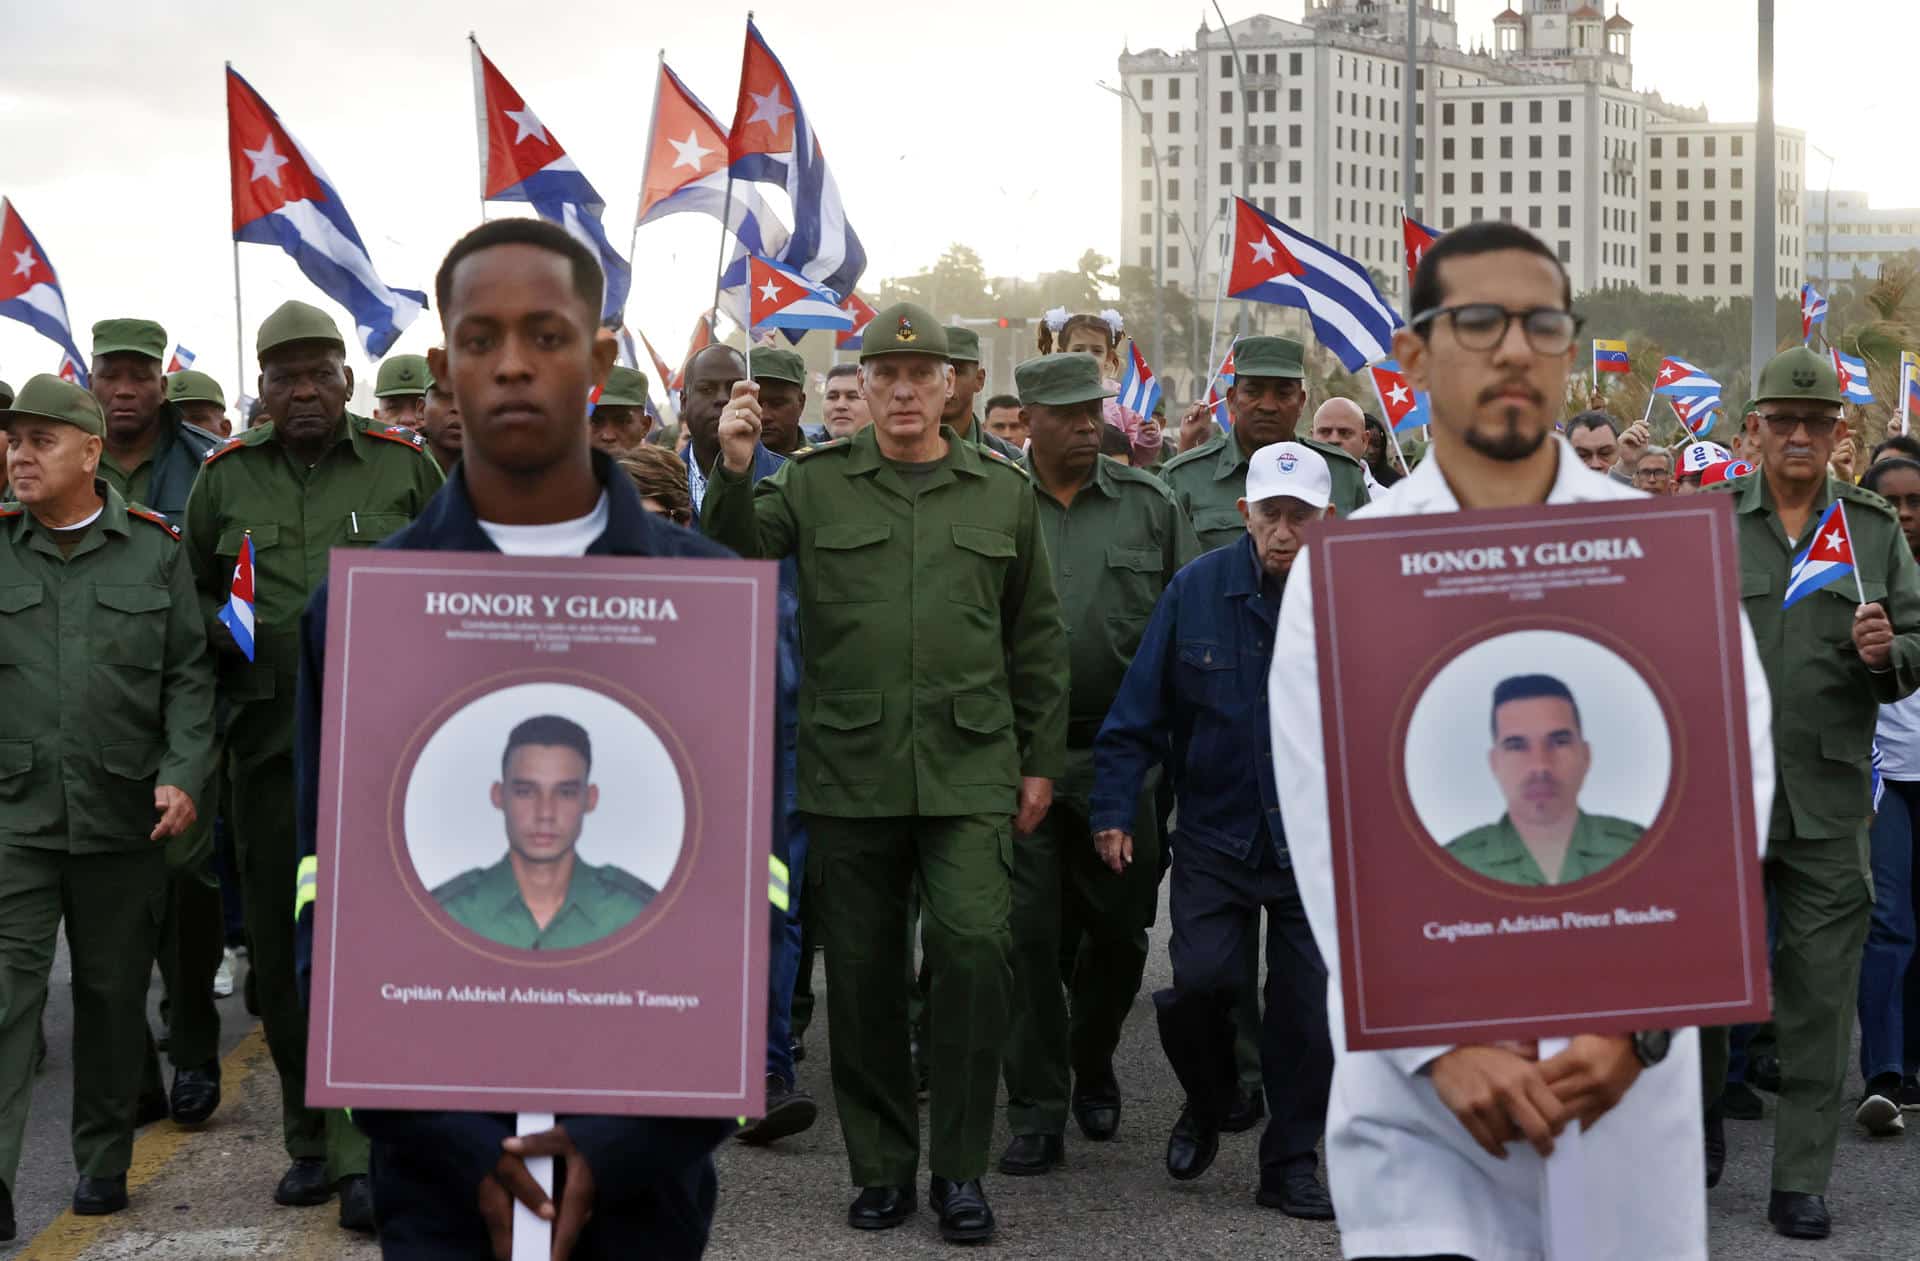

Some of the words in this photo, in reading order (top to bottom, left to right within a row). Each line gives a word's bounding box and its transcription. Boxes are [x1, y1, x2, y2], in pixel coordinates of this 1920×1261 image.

[1401, 547, 1506, 576] HONOR
[1510, 546, 1530, 567] Y
[1534, 537, 1644, 566] GLORIA
[425, 592, 534, 617] HONOR
[541, 596, 560, 617] Y
[566, 596, 678, 621] GLORIA
[381, 983, 442, 1004] Capitán
[510, 987, 565, 1004] Adrián
[636, 990, 699, 1011] Tamayo
